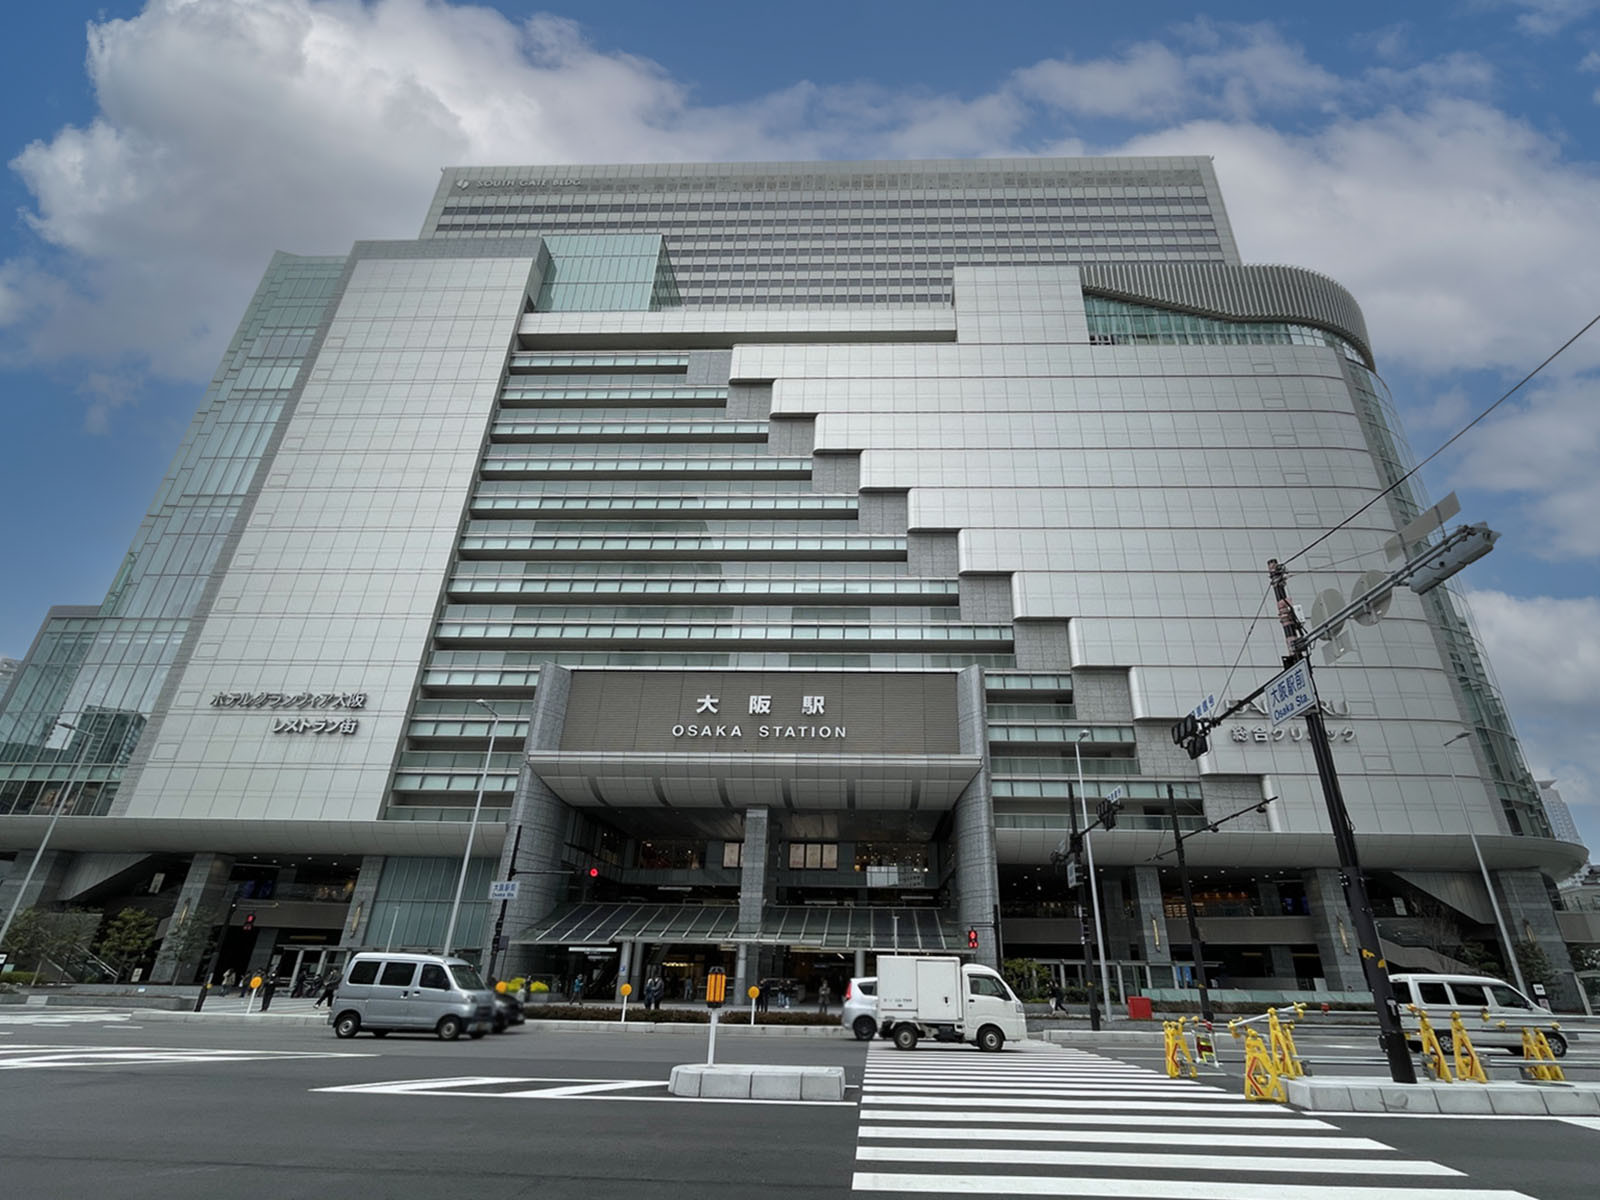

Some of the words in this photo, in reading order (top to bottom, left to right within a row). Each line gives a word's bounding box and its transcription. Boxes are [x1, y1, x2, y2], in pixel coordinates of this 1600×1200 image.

[1271, 669, 1305, 708] 大阪駅前
[210, 691, 367, 710] ホテルグランヴィア大阪
[696, 694, 825, 715] 大阪駅
[1274, 702, 1295, 721] Osaka
[272, 718, 358, 736] レストラン街
[672, 724, 742, 737] OSAKA
[759, 725, 846, 738] STATION
[1231, 726, 1356, 742] 総合クリック
